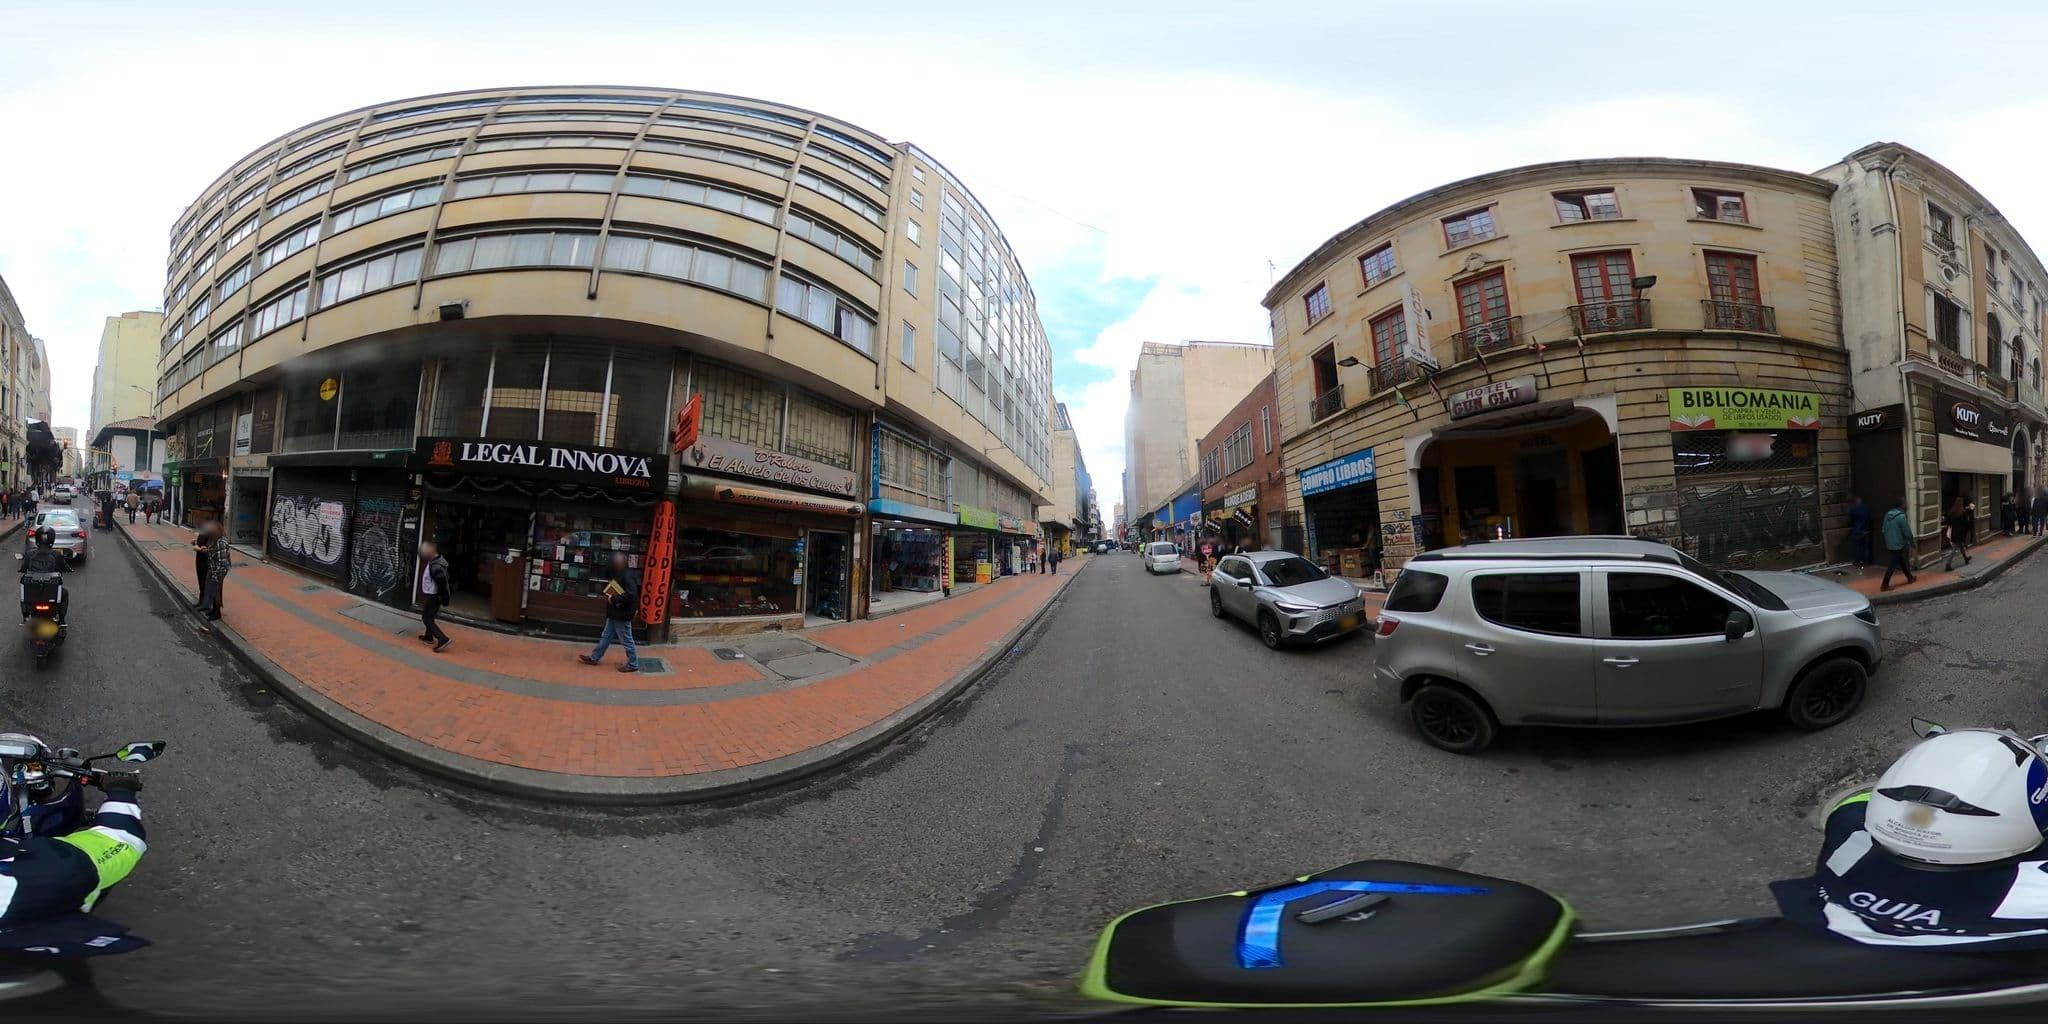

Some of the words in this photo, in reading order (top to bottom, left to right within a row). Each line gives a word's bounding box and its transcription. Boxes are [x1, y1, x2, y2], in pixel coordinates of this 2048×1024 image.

[1410, 287, 1426, 352] HOTEL
[1465, 381, 1513, 399] HOTEL
[1453, 397, 1482, 415] GUN
[1682, 391, 1812, 410] BIBLIOMANIA
[1858, 413, 1882, 427] KUTY
[1956, 406, 1980, 425] KUTY
[460, 442, 545, 467] LEGAL
[548, 447, 651, 478] INNOVA
[708, 455, 725, 469] El
[726, 458, 771, 478] Abuelo
[774, 469, 788, 481] de
[791, 472, 808, 486] los
[1301, 468, 1335, 491] COMPRO
[1335, 456, 1373, 482] LIBROS
